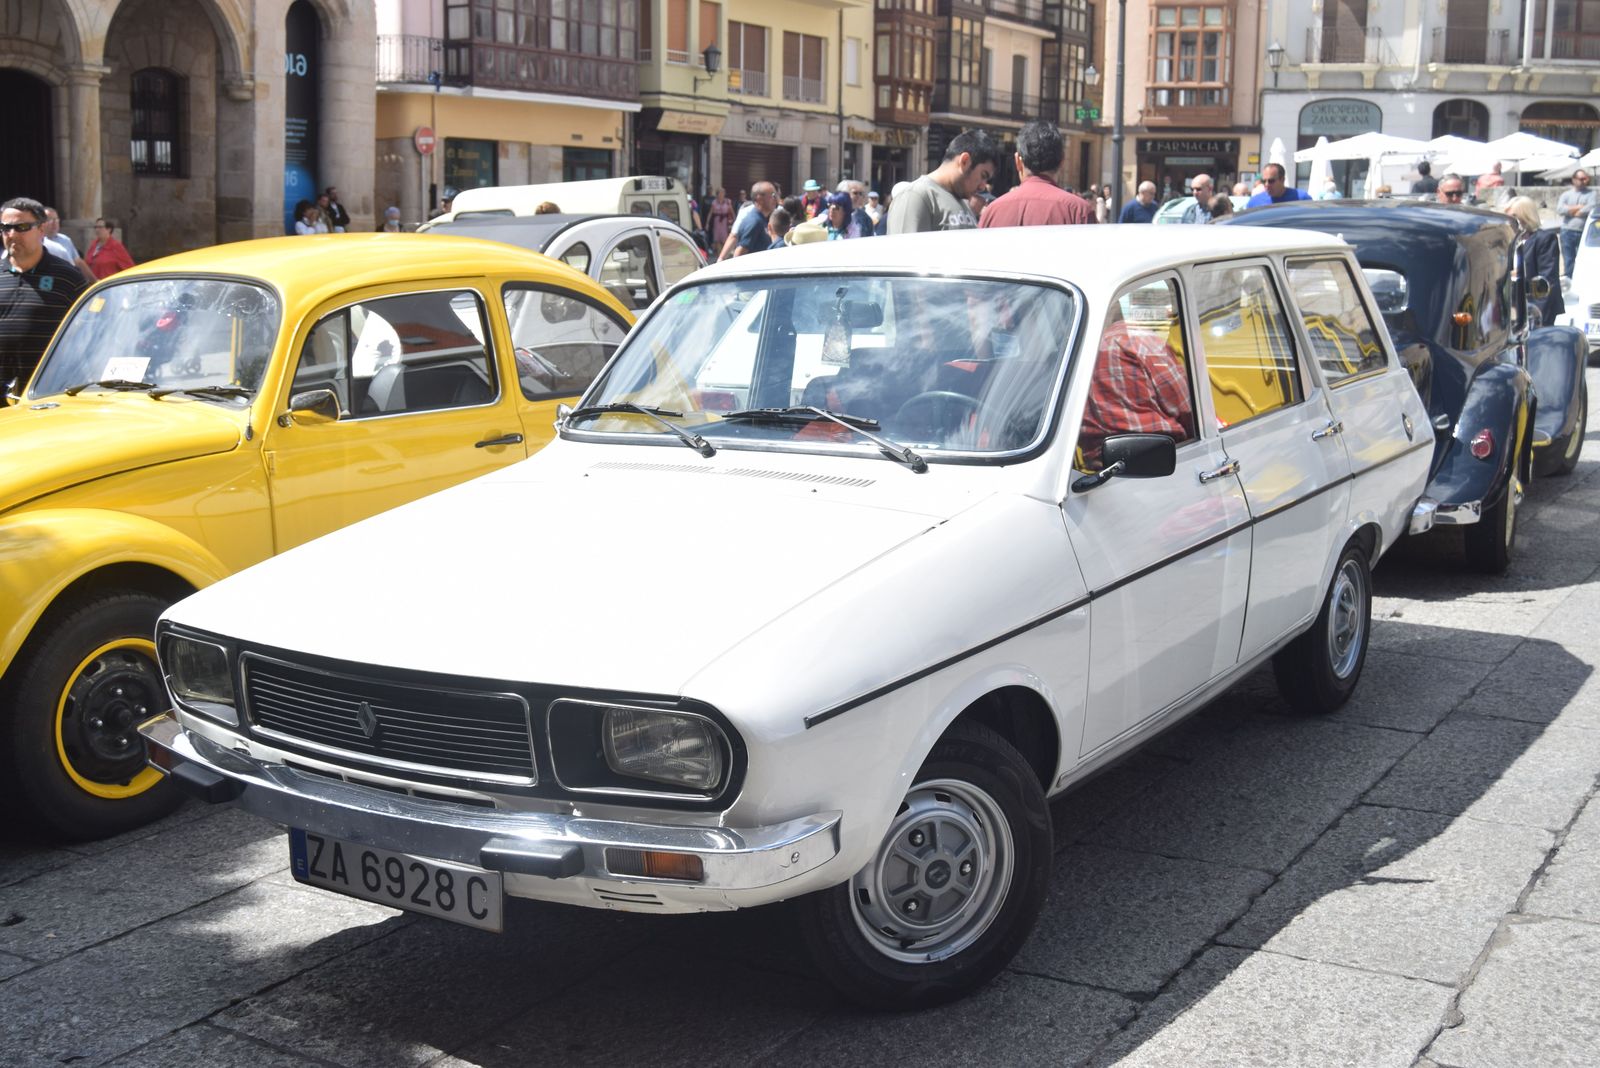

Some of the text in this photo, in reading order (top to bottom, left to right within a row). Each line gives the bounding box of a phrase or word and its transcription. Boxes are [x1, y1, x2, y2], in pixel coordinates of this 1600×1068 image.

[1311, 104, 1370, 114] ORTOPEDIA
[1311, 115, 1370, 125] ZAMORANA
[1157, 141, 1219, 152] FARMACIA
[296, 858, 305, 871] E
[307, 835, 489, 920] ZA 6928 C
